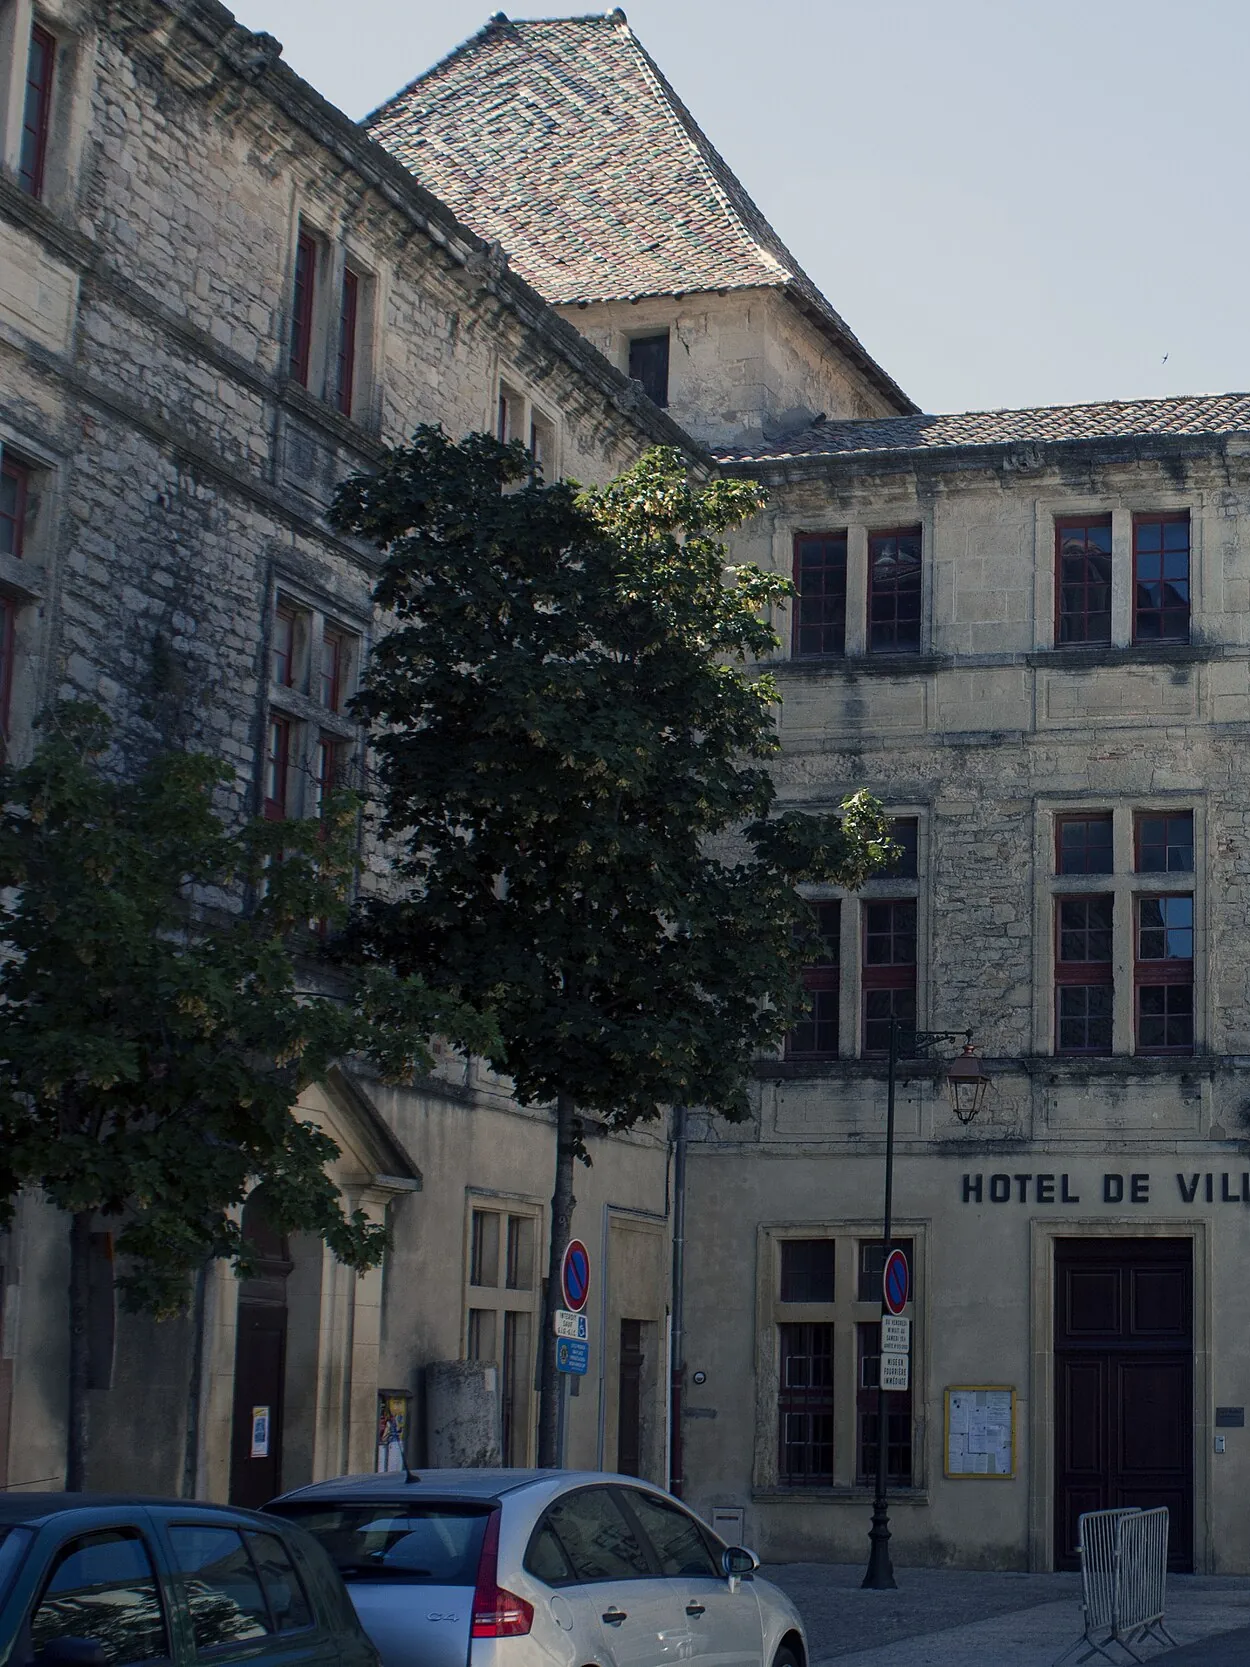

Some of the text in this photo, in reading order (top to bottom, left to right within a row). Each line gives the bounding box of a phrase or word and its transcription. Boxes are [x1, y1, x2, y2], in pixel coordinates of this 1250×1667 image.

[962, 1173, 1080, 1204] HOTEL
[1103, 1173, 1150, 1204] DE
[427, 1611, 460, 1622] C4
